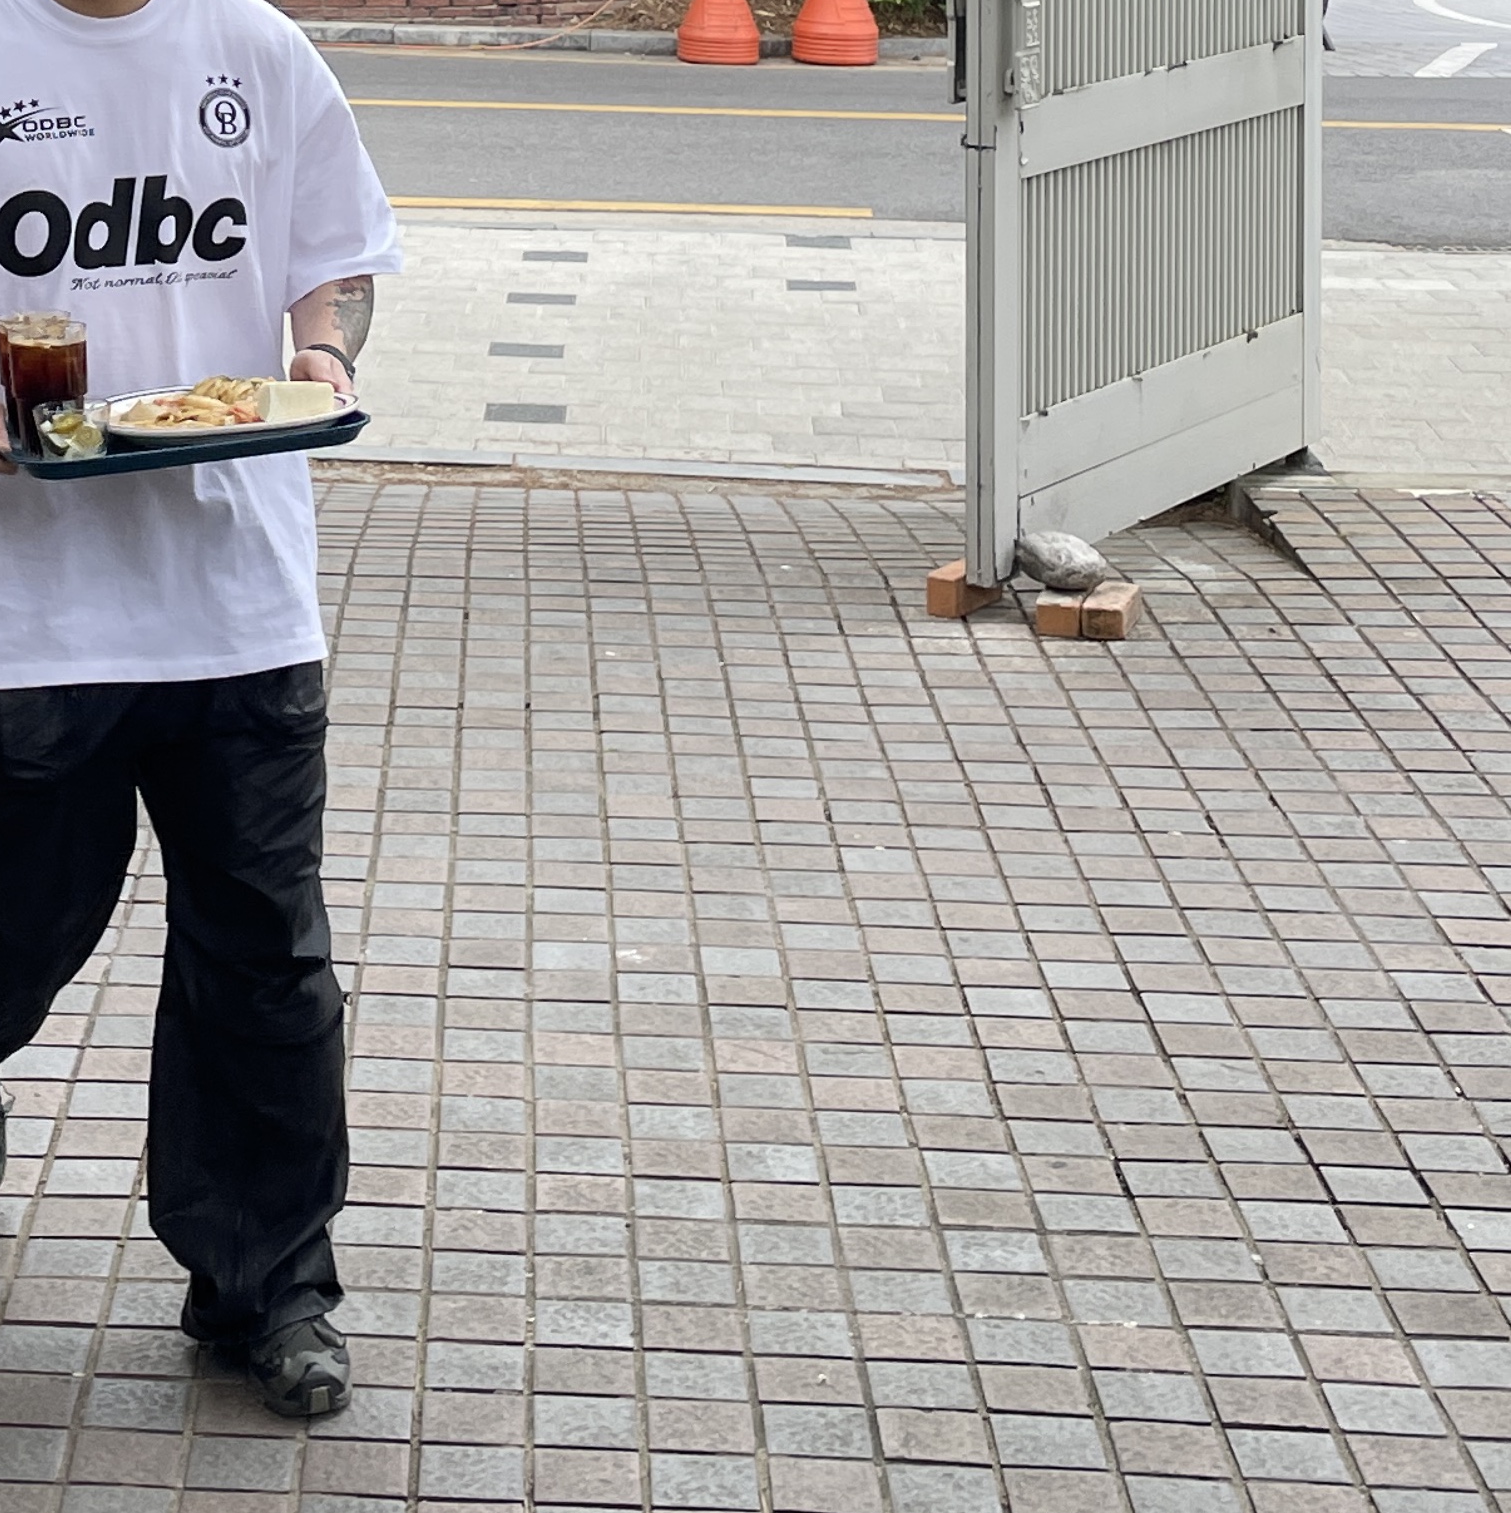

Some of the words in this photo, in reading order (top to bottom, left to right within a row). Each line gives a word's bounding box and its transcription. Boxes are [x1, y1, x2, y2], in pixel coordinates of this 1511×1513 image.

[22, 114, 87, 133] ODBC
[24, 128, 96, 143] WORLDWIDE
[70, 276, 101, 292] Not
